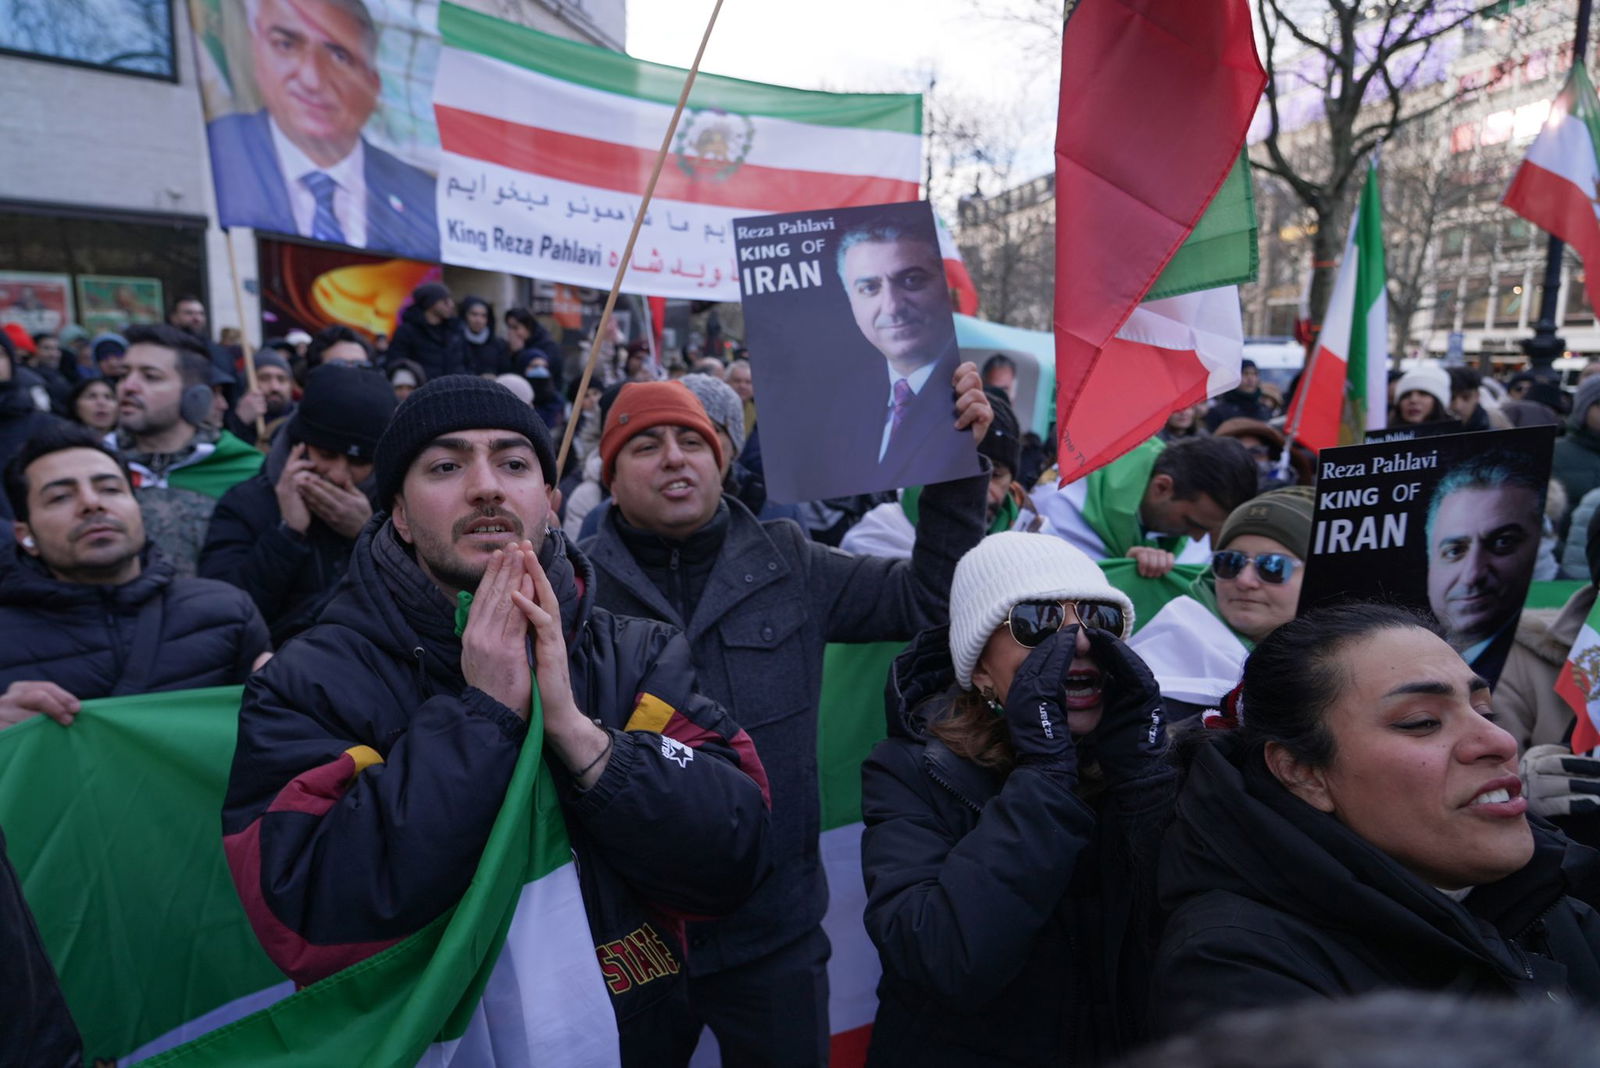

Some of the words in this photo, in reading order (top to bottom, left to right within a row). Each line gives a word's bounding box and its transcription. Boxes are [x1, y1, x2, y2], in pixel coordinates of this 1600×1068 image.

[447, 218, 488, 252] King
[494, 227, 534, 256] Reza
[540, 235, 602, 267] Pahlavi
[737, 226, 774, 240] Reza
[778, 217, 836, 236] Pahlavi
[740, 243, 791, 262] KING
[801, 238, 826, 255] OF
[743, 260, 823, 296] IRAN
[1321, 462, 1366, 480] Reza
[1372, 450, 1438, 473] Pahlavi
[1320, 487, 1379, 510] KING
[1392, 482, 1422, 502] OF
[1313, 512, 1409, 555] IRAN
[595, 922, 681, 994] STATE
